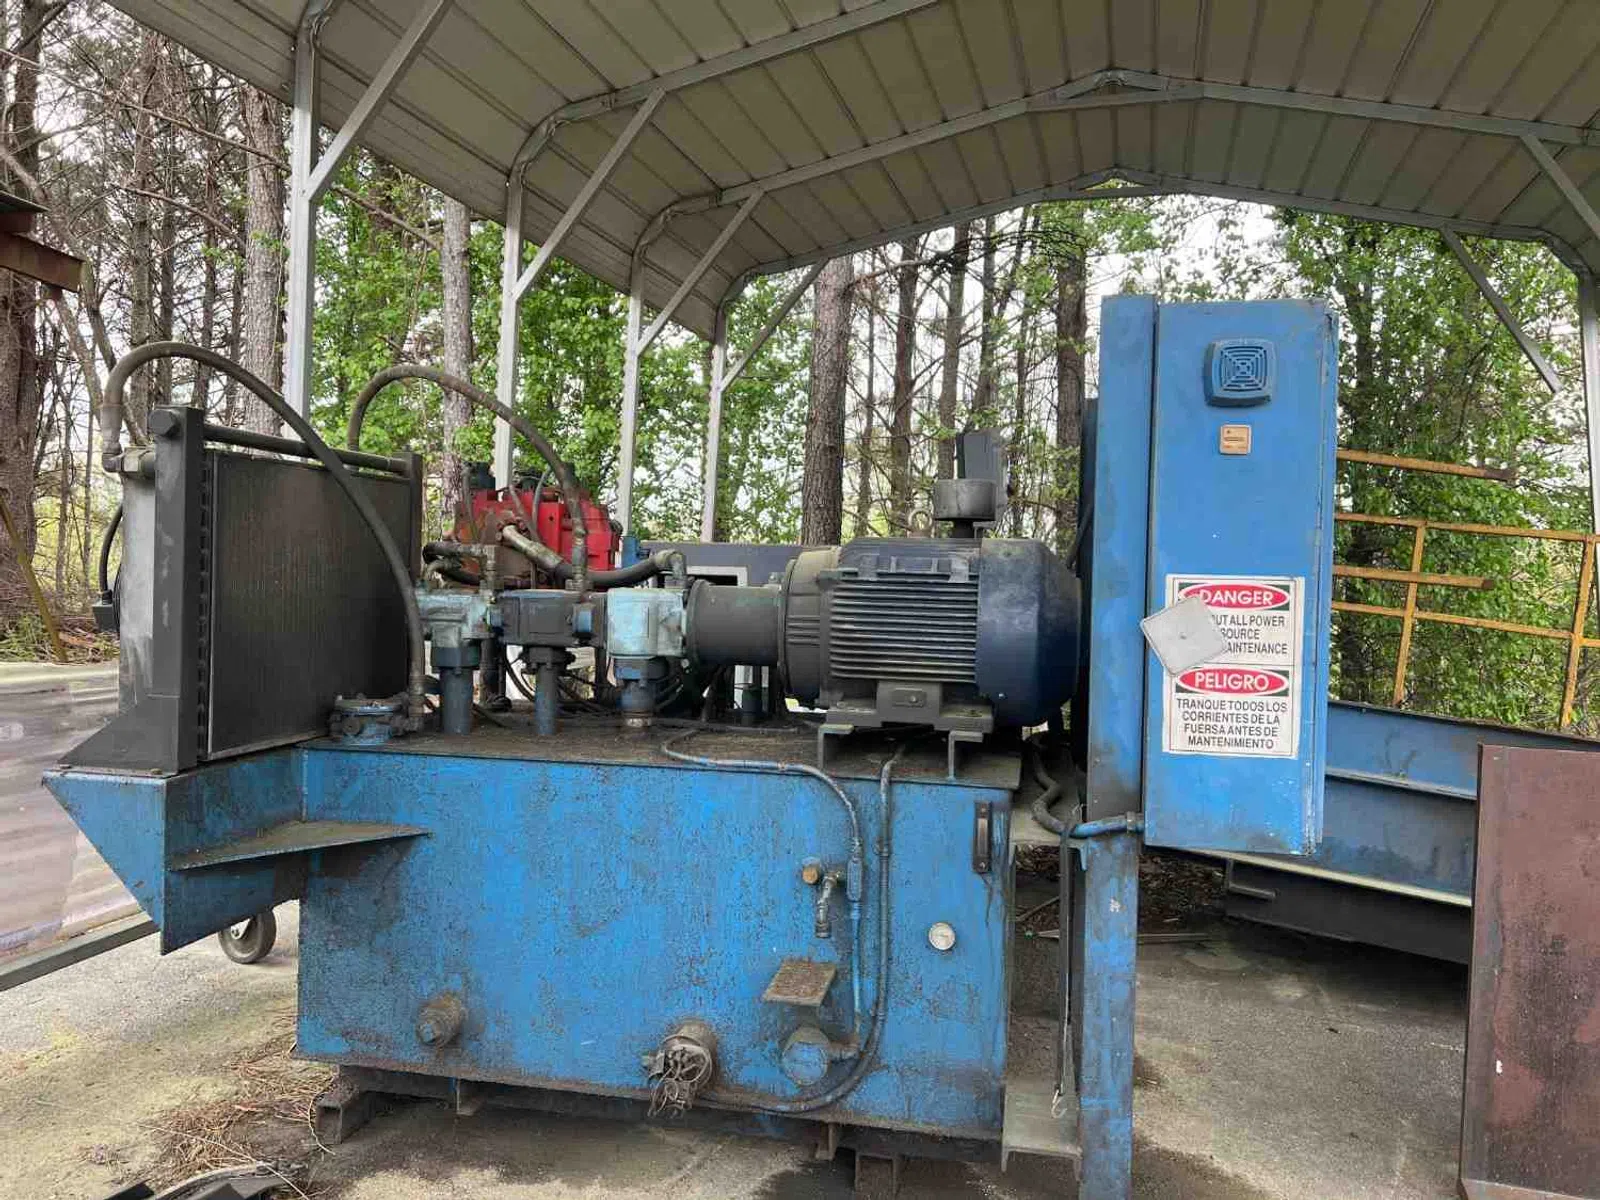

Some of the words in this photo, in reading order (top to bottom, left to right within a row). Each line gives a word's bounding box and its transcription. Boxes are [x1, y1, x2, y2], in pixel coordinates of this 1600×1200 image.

[1199, 588, 1274, 606] DANGER
[1212, 614, 1229, 626] UT
[1229, 615, 1248, 626] ALL
[1250, 615, 1285, 627] POWER
[1220, 628, 1260, 640] SOURCE
[1224, 642, 1288, 654] AINTENANCE
[1194, 672, 1269, 691] PELIGRO
[1177, 698, 1226, 711] TRANQUE
[1229, 700, 1264, 712] TODOS
[1266, 701, 1287, 713] LOS
[1182, 711, 1250, 724] CORRIENTES
[1251, 713, 1264, 724] DE
[1266, 713, 1280, 725] LA
[1184, 723, 1226, 735] FUERSA
[1227, 725, 1263, 737] ANTES
[1264, 726, 1278, 737] DE
[1187, 735, 1274, 749] MANTENIMIENTO
